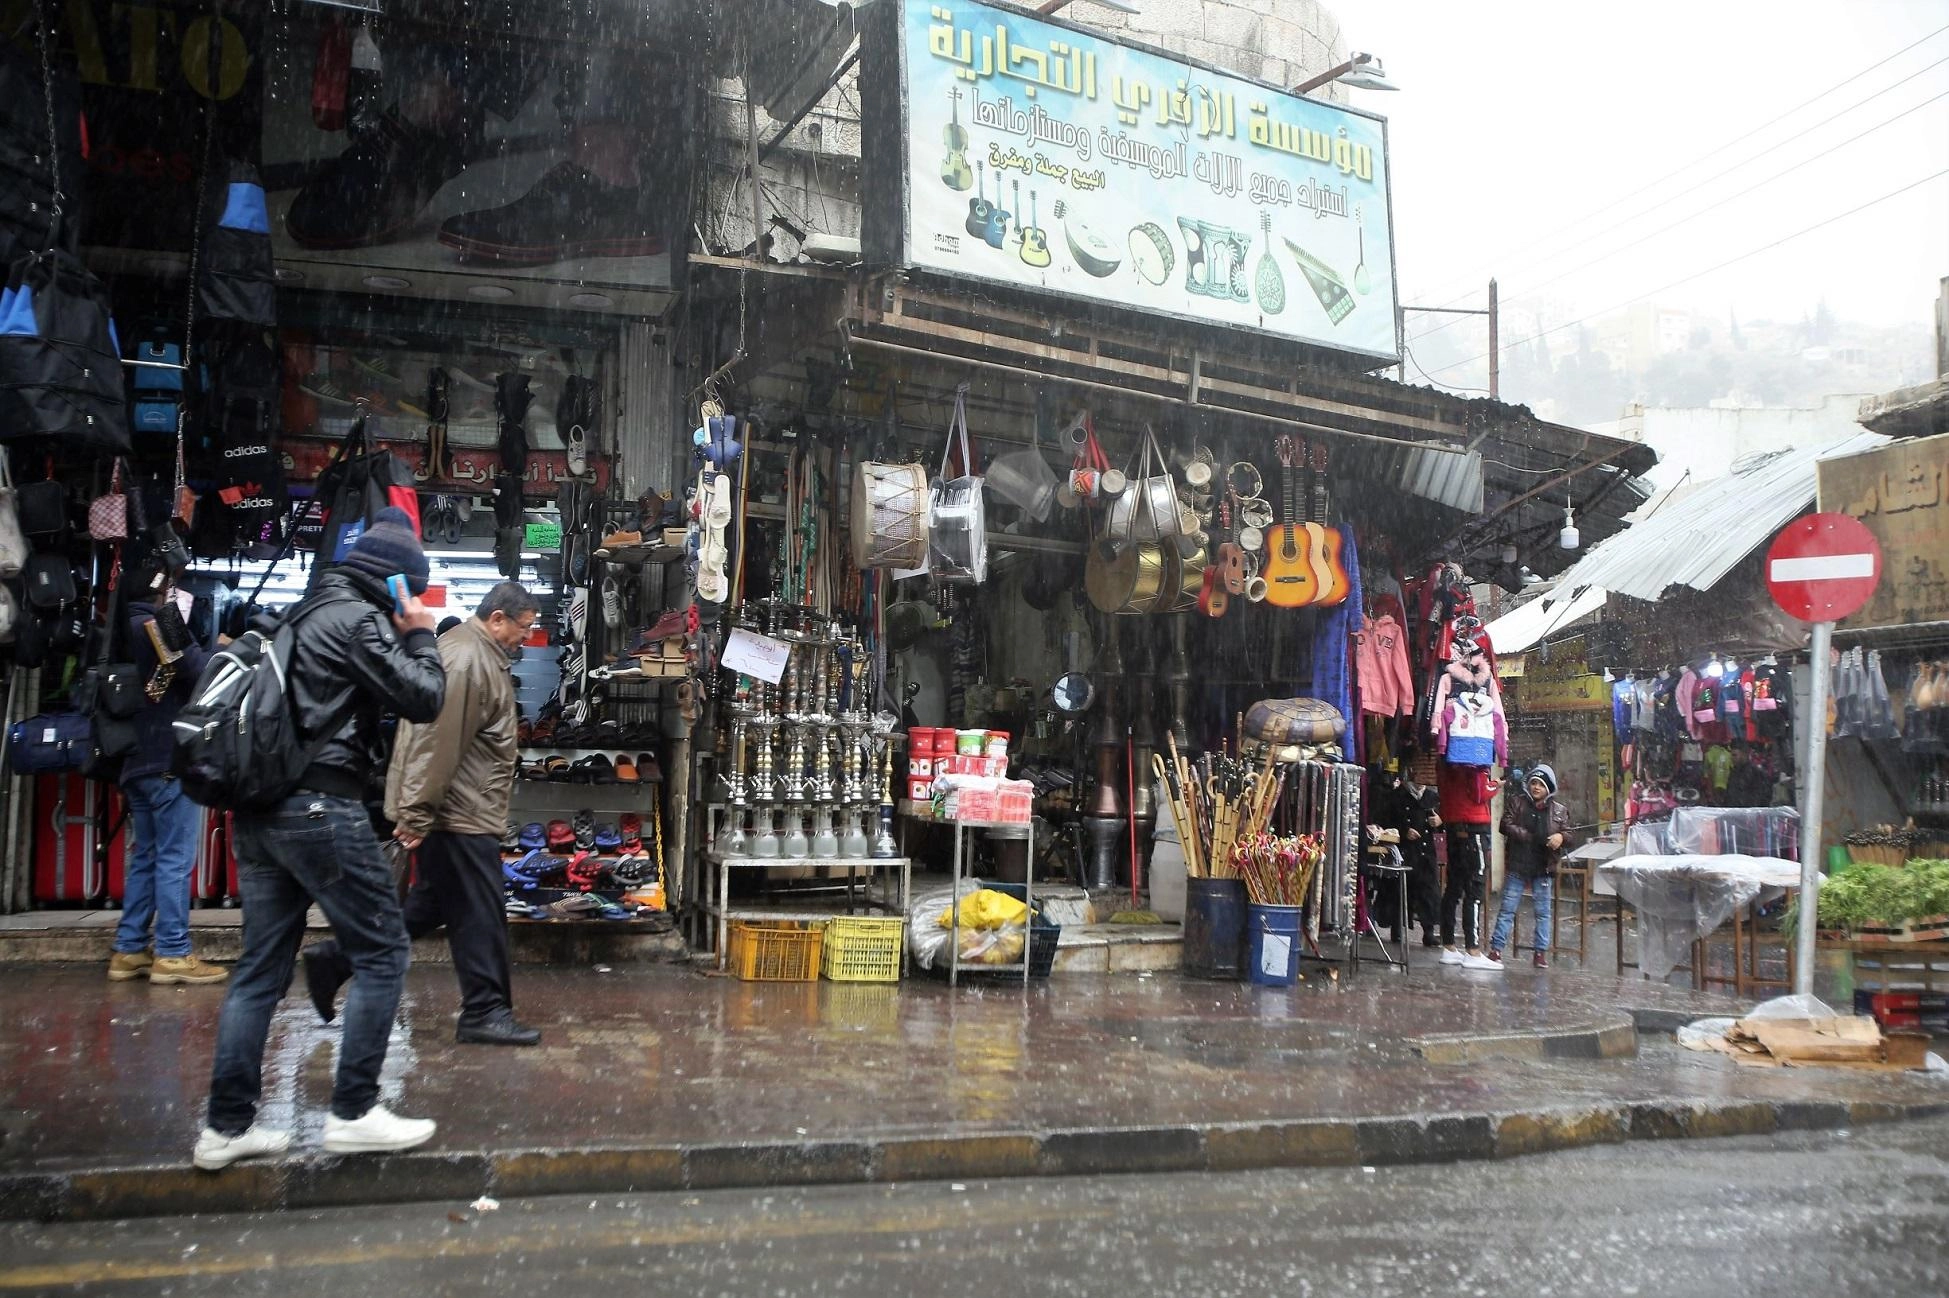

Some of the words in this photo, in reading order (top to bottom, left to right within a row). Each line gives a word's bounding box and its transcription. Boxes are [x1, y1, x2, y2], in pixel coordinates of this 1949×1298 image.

[929, 5, 1096, 98] التجارية
[972, 87, 1091, 161] ومستلزماتها
[1249, 100, 1373, 181] مؤسسة
[989, 142, 1033, 175] ومفرق
[1036, 153, 1068, 184] جملة
[1098, 126, 1188, 179] الموسيقية
[1071, 168, 1105, 191] البيع
[1249, 172, 1292, 206] جميع
[1298, 177, 1348, 219] استيراد
[225, 445, 268, 457] adidas
